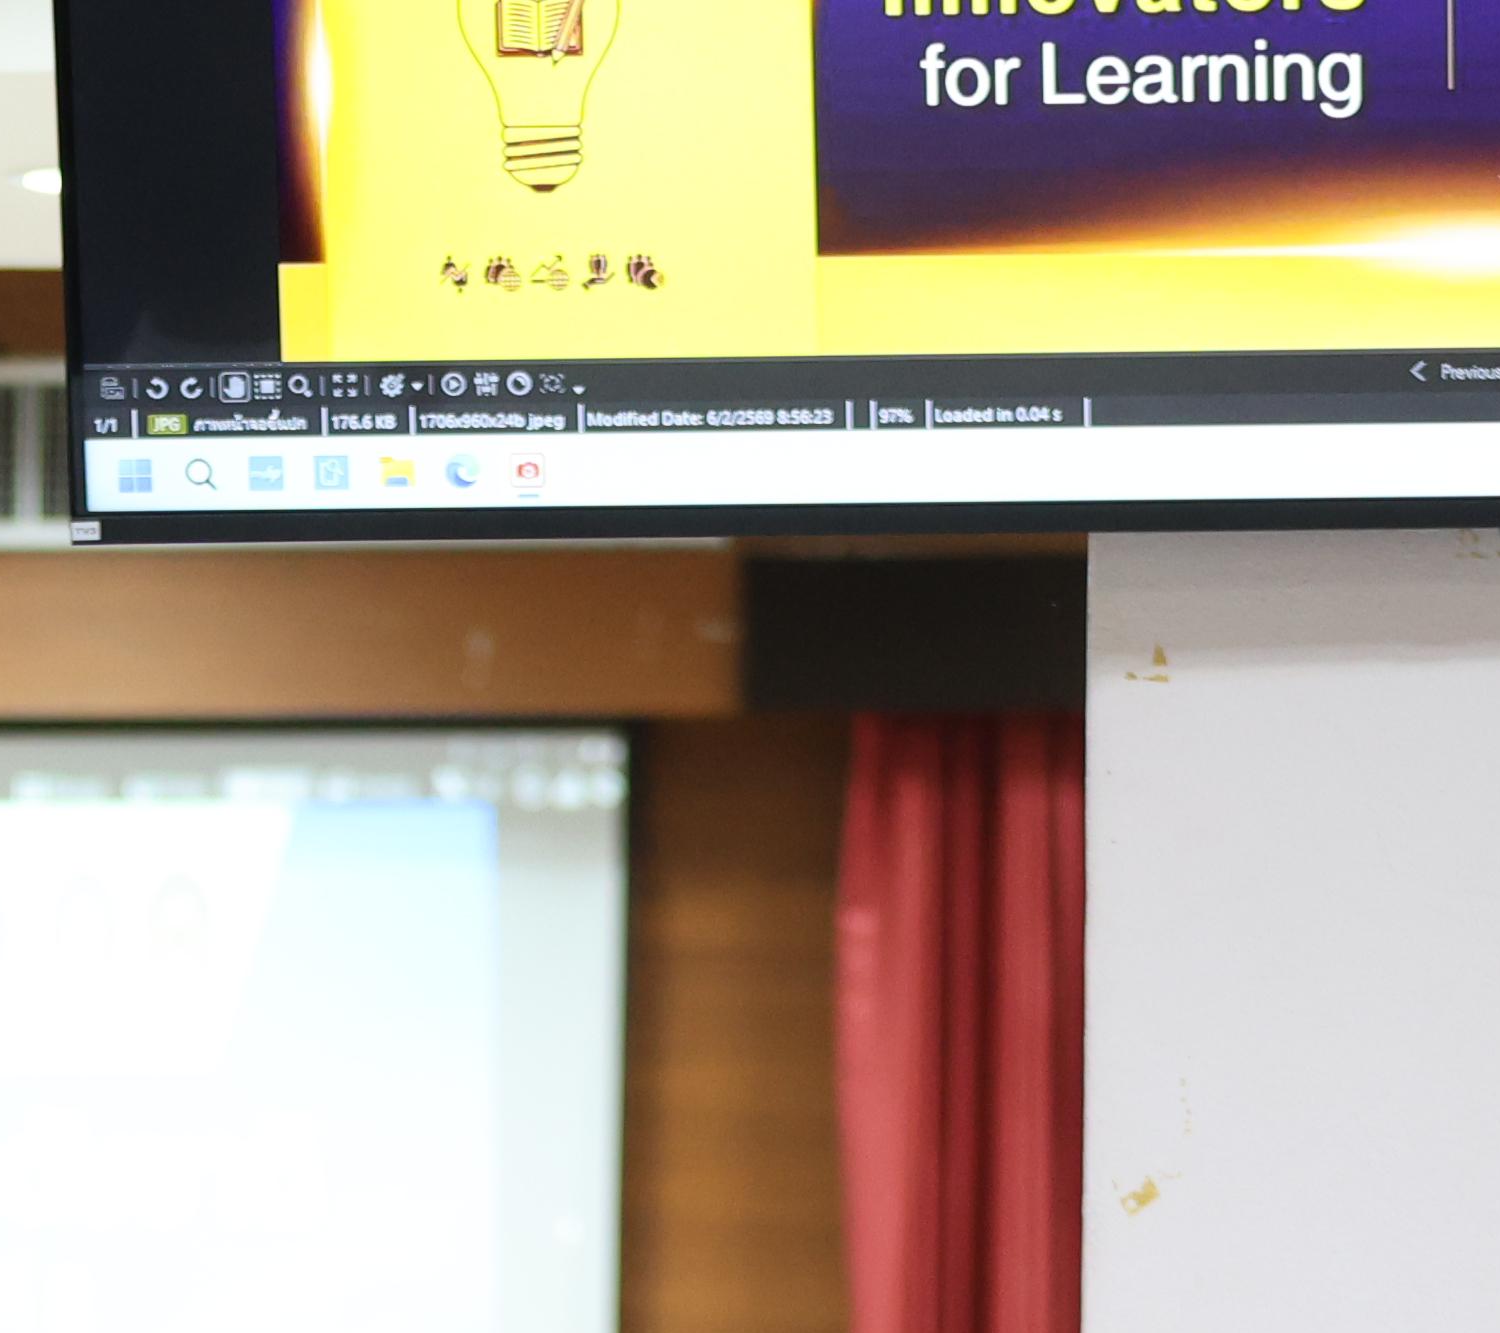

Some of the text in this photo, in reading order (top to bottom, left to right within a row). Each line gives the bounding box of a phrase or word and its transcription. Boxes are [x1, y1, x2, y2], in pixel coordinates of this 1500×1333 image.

[919, 39, 1363, 118] for Learning
[374, 414, 397, 430] KB
[526, 412, 566, 430] jpeg
[587, 410, 658, 427] Modified
[661, 410, 704, 427] Date:
[706, 409, 774, 426] 6/2/2569
[879, 408, 914, 423] 97%
[935, 407, 993, 422] Loaded
[996, 407, 1013, 422] in
[1015, 406, 1050, 422] 0.04
[94, 418, 118, 433] 1/1
[153, 418, 181, 433] JPG
